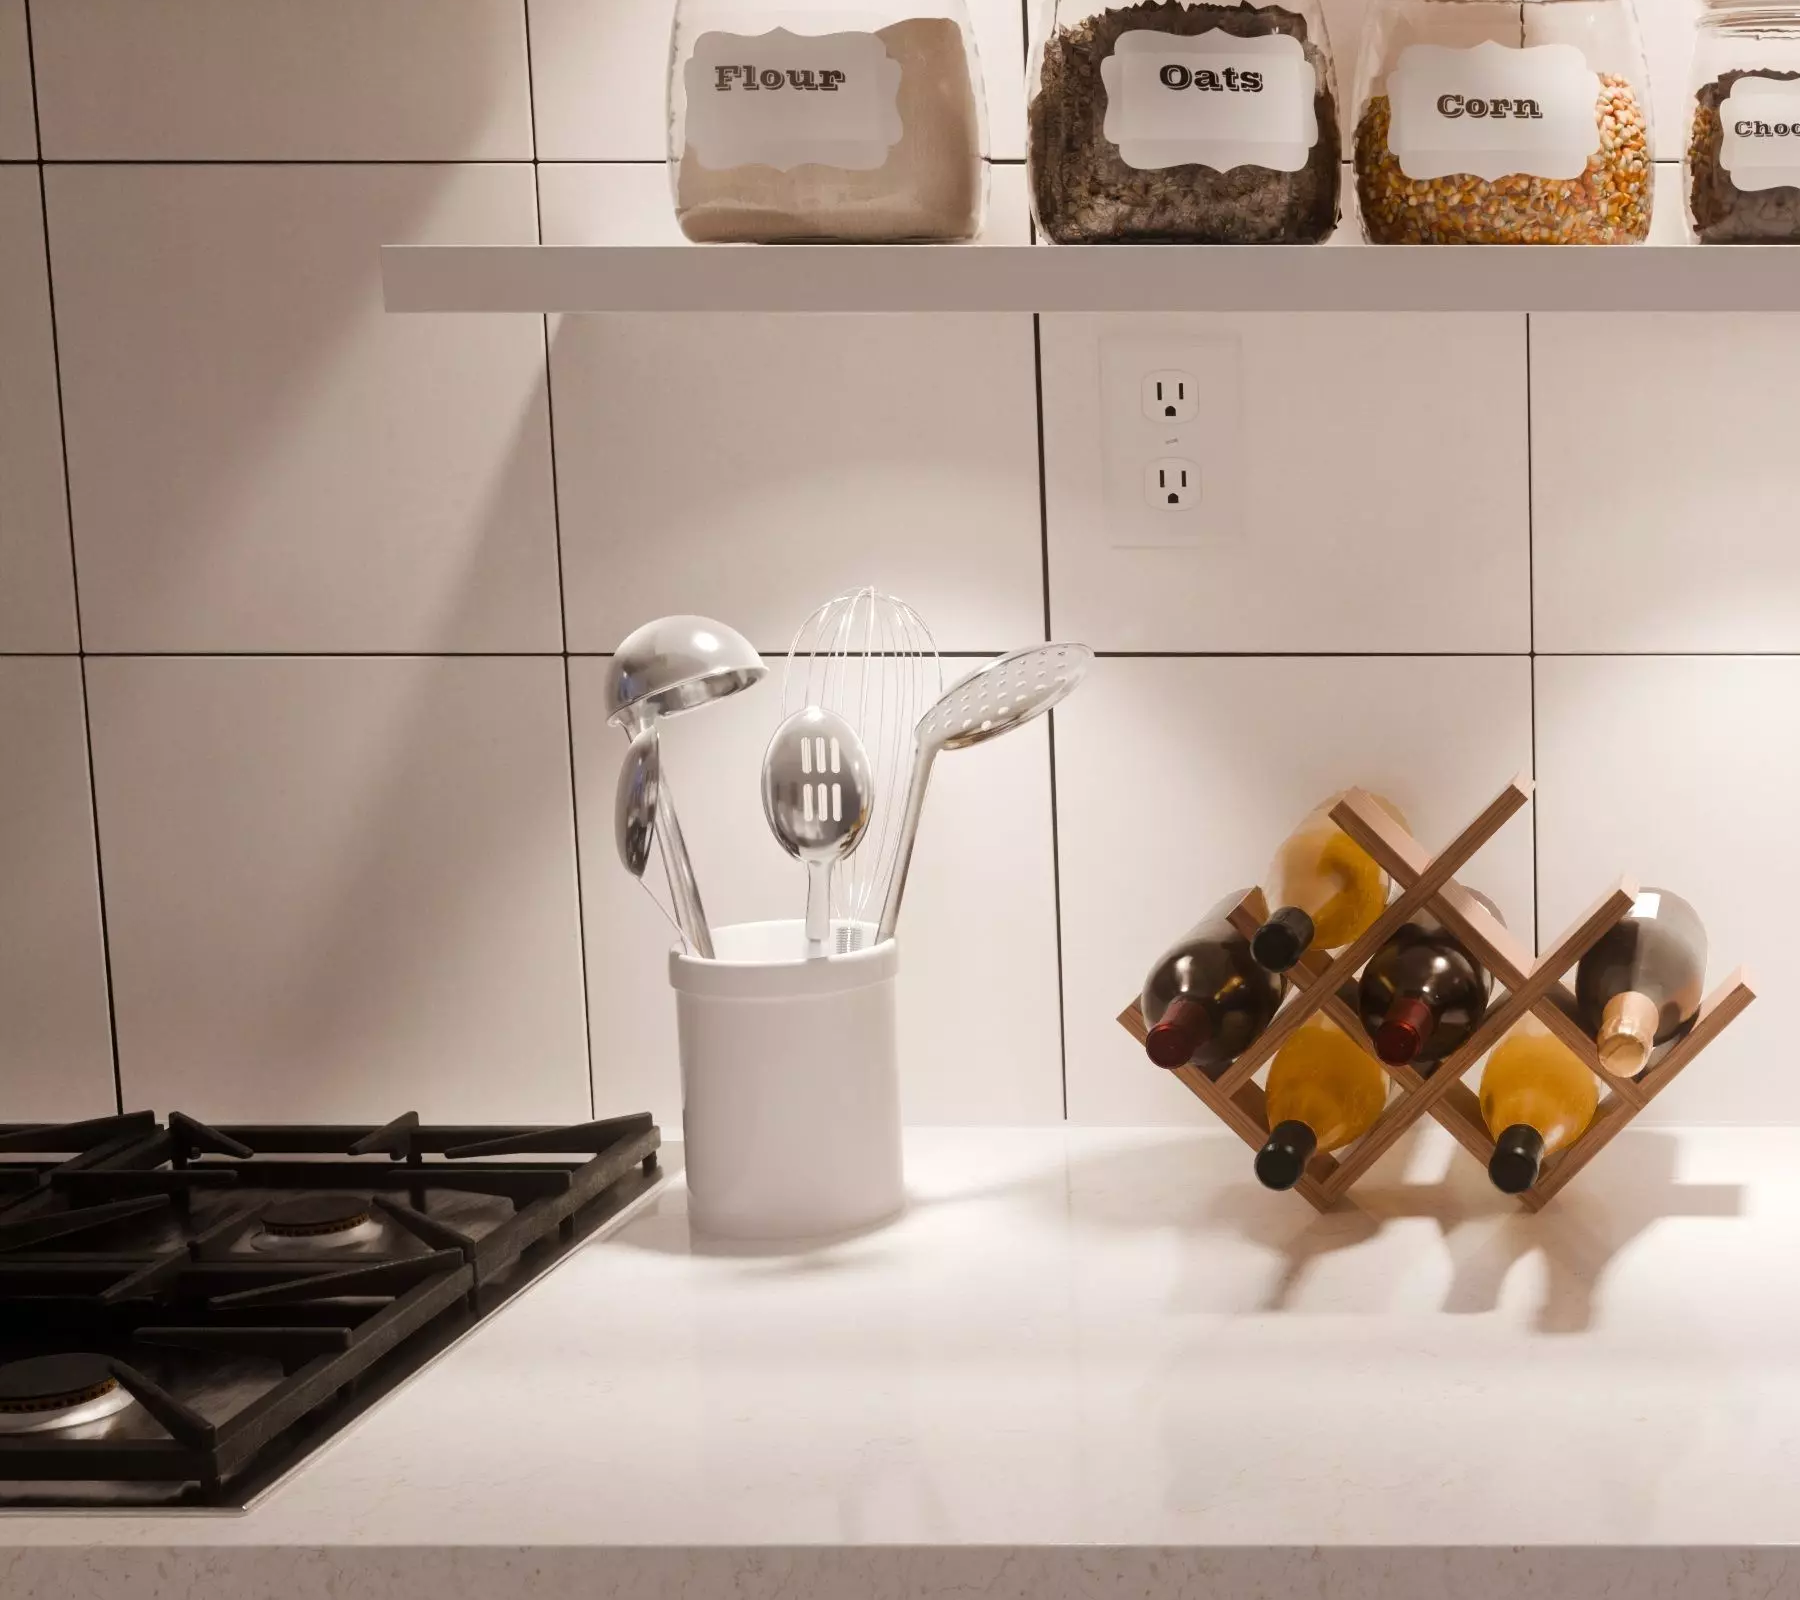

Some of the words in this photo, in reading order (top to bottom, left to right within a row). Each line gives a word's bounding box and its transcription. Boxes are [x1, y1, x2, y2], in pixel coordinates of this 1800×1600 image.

[715, 64, 845, 92] Flour
[1158, 63, 1264, 93] Oats
[1436, 94, 1543, 119] Corn
